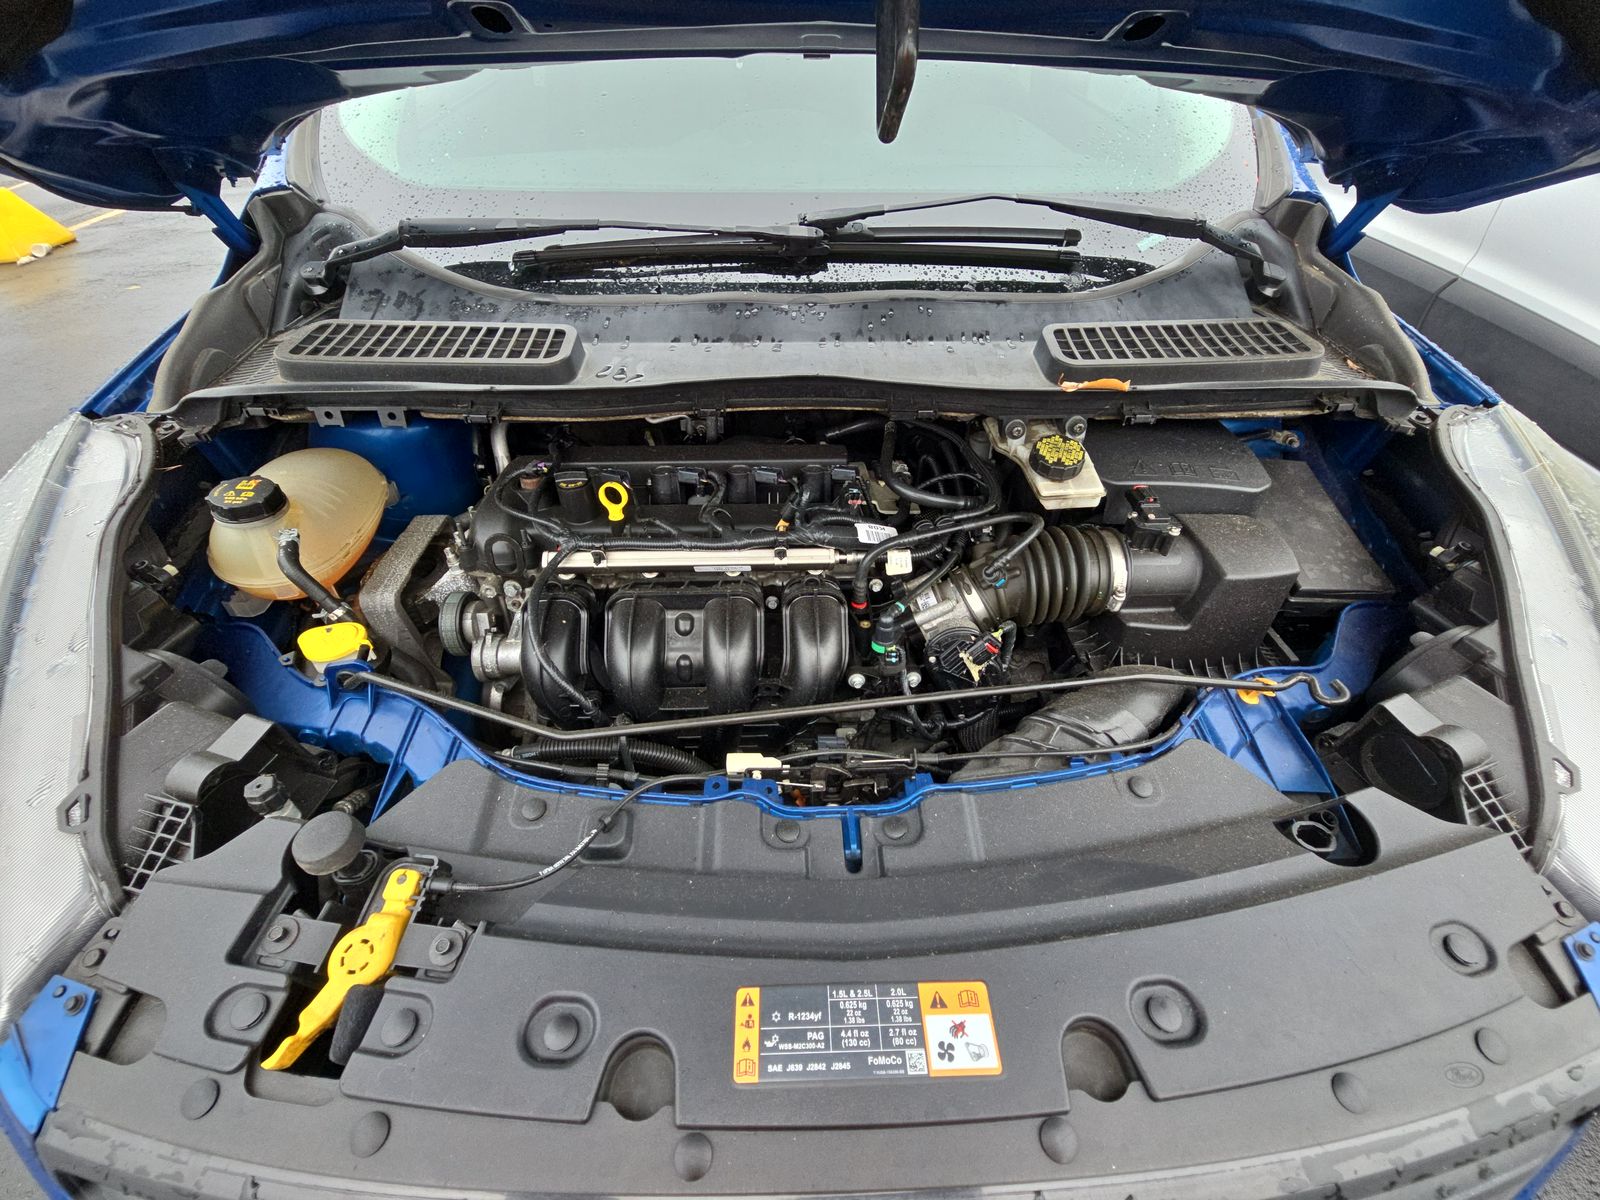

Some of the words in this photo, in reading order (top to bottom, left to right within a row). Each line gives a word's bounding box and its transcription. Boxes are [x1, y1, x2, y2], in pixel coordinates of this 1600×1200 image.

[832, 990, 848, 998] 1.5L
[850, 989, 856, 997] &
[857, 989, 873, 997] 2.5L
[890, 988, 906, 996] 2.0L
[840, 1001, 857, 1009] 0.625
[858, 1001, 867, 1010] kg
[886, 1000, 903, 1008] 0.625
[905, 999, 914, 1009] kg
[788, 1011, 822, 1022] R-1234yf
[807, 1031, 824, 1040] PAG
[841, 1030, 852, 1038] 4.4
[889, 1028, 899, 1036] 2.7
[901, 1028, 906, 1036] fl
[842, 1039, 857, 1048] (130
[859, 1039, 870, 1048] cc)
[905, 1037, 917, 1046] cc)
[868, 1056, 902, 1065] FoMoCo
[767, 1064, 783, 1072] SAE
[806, 1062, 826, 1071] J2842
[830, 1062, 851, 1070] J2845
